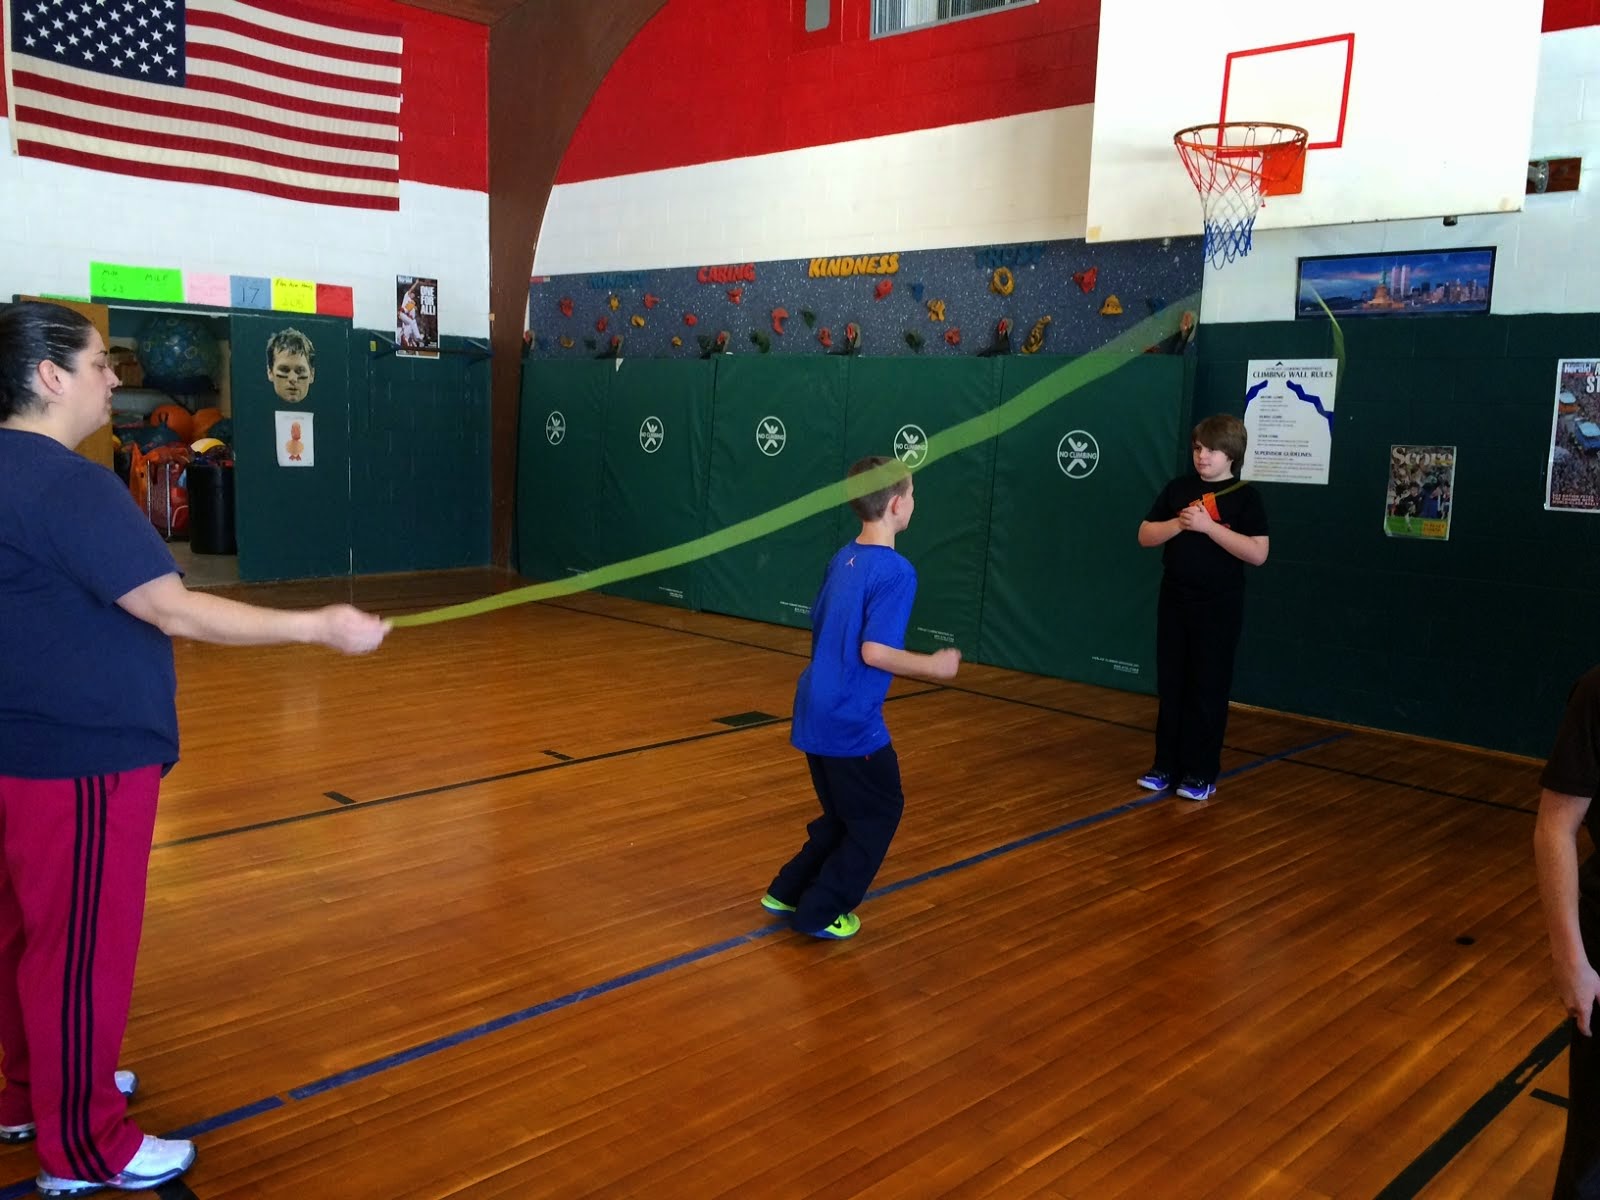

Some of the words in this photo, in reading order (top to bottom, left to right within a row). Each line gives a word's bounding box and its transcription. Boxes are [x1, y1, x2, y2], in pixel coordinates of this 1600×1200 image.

[808, 253, 899, 277] KINDNESS
[697, 262, 756, 284] CARING
[242, 287, 260, 304] 17
[420, 285, 435, 297] ONE
[420, 296, 435, 306] FOR
[1564, 363, 1592, 374] Herald
[1252, 371, 1286, 379] CLIMBING
[904, 443, 926, 451] CLIMBING
[1069, 451, 1097, 460] CLIMBING
[1392, 447, 1453, 466] Score
